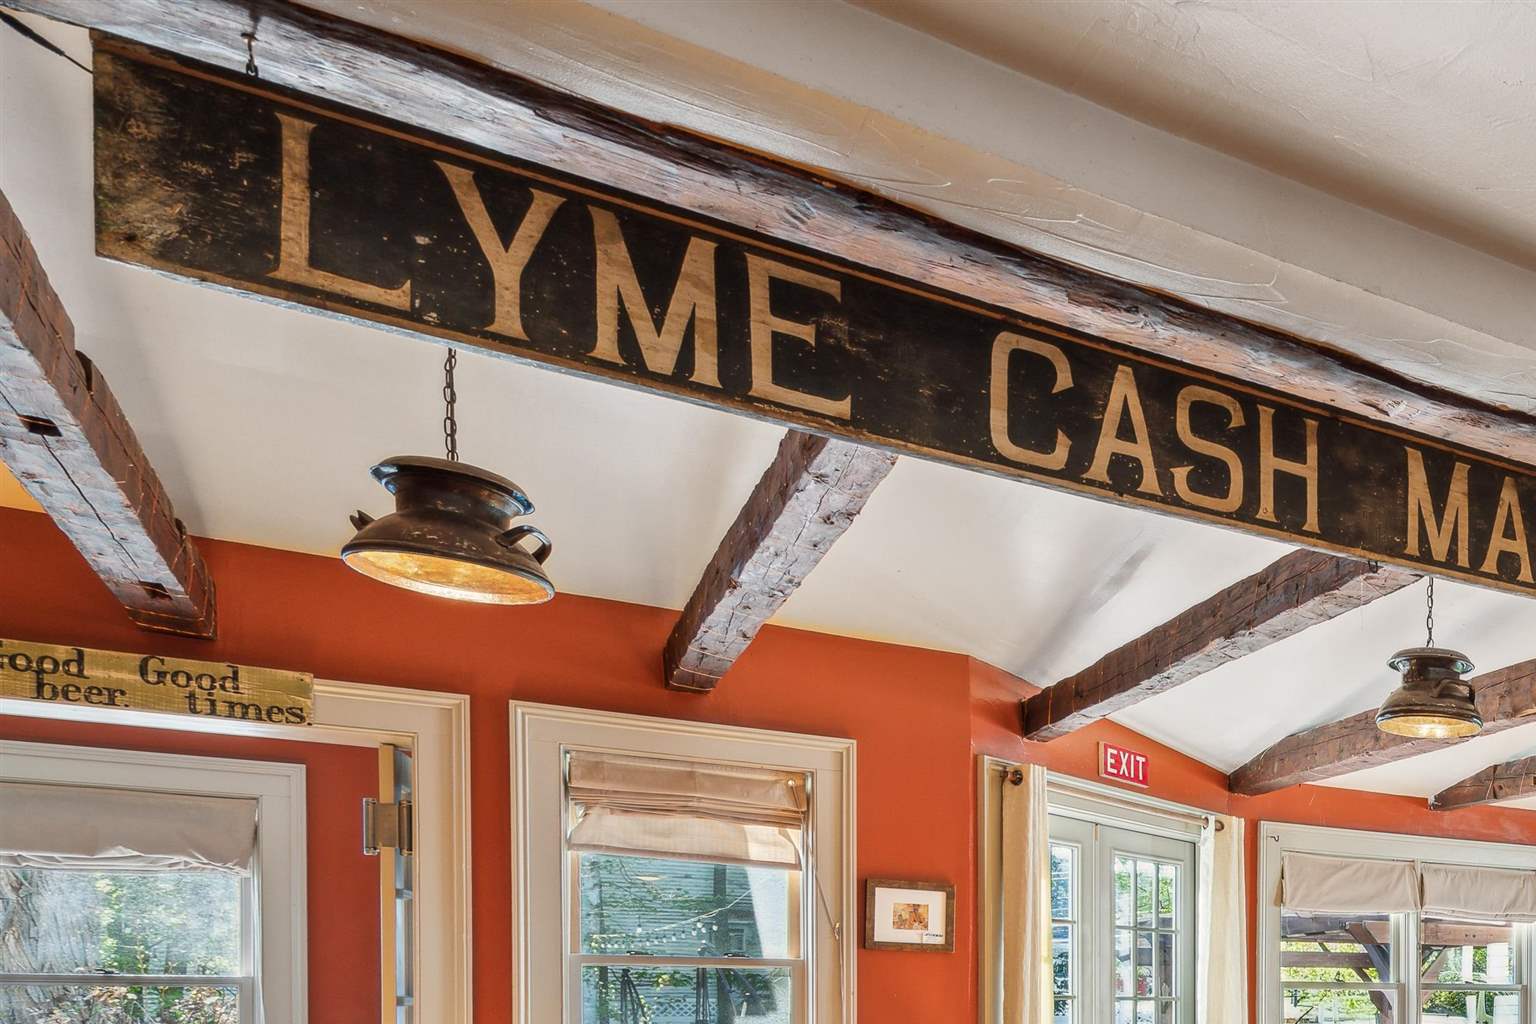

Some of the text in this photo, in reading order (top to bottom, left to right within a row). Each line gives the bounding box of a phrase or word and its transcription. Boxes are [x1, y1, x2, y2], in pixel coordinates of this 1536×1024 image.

[267, 111, 853, 421] LYME
[990, 331, 1320, 534] CASH
[30, 670, 312, 726] beer. times.
[138, 655, 244, 694] Good
[1107, 747, 1146, 780] EXIT
